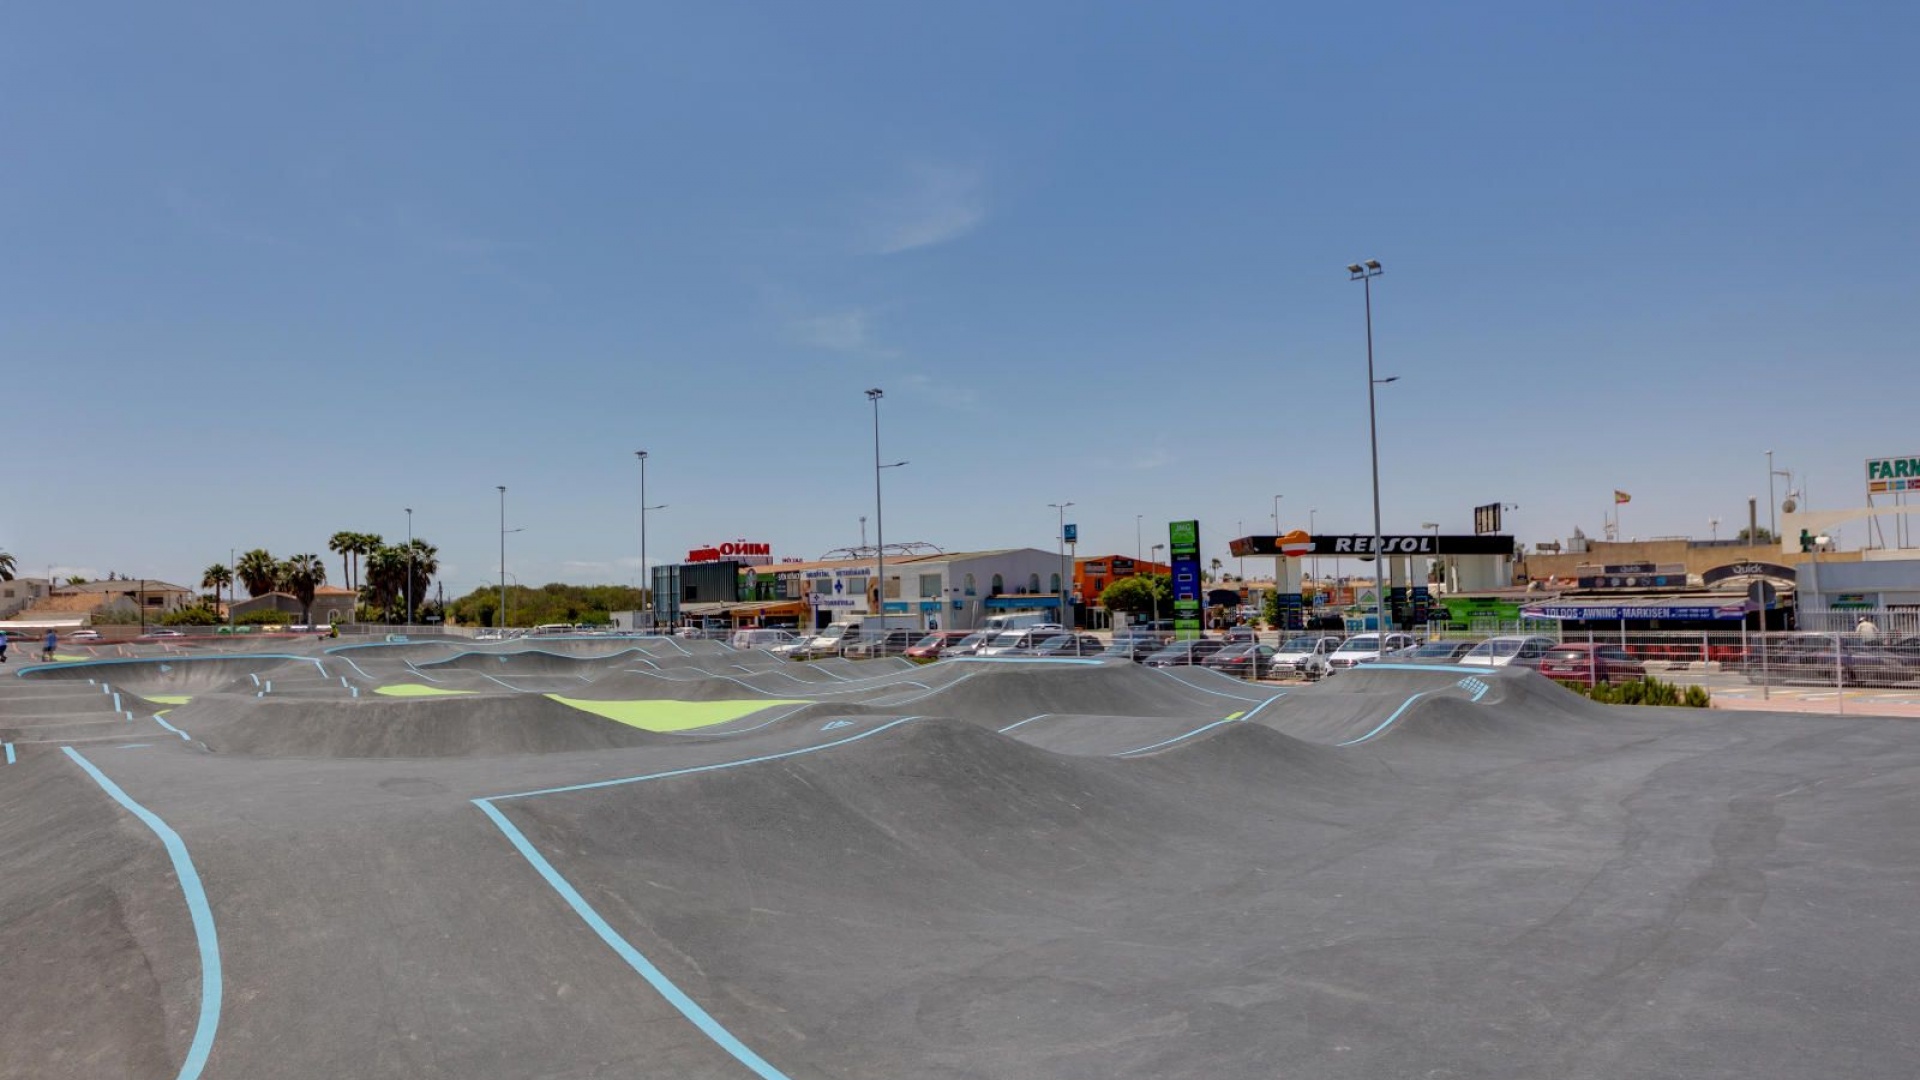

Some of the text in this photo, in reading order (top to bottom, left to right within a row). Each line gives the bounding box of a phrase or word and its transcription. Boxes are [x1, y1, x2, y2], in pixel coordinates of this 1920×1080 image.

[1335, 537, 1431, 552] REPSOL
[1583, 607, 1618, 618] AWNING
[1622, 607, 1670, 618] MARKISEN
